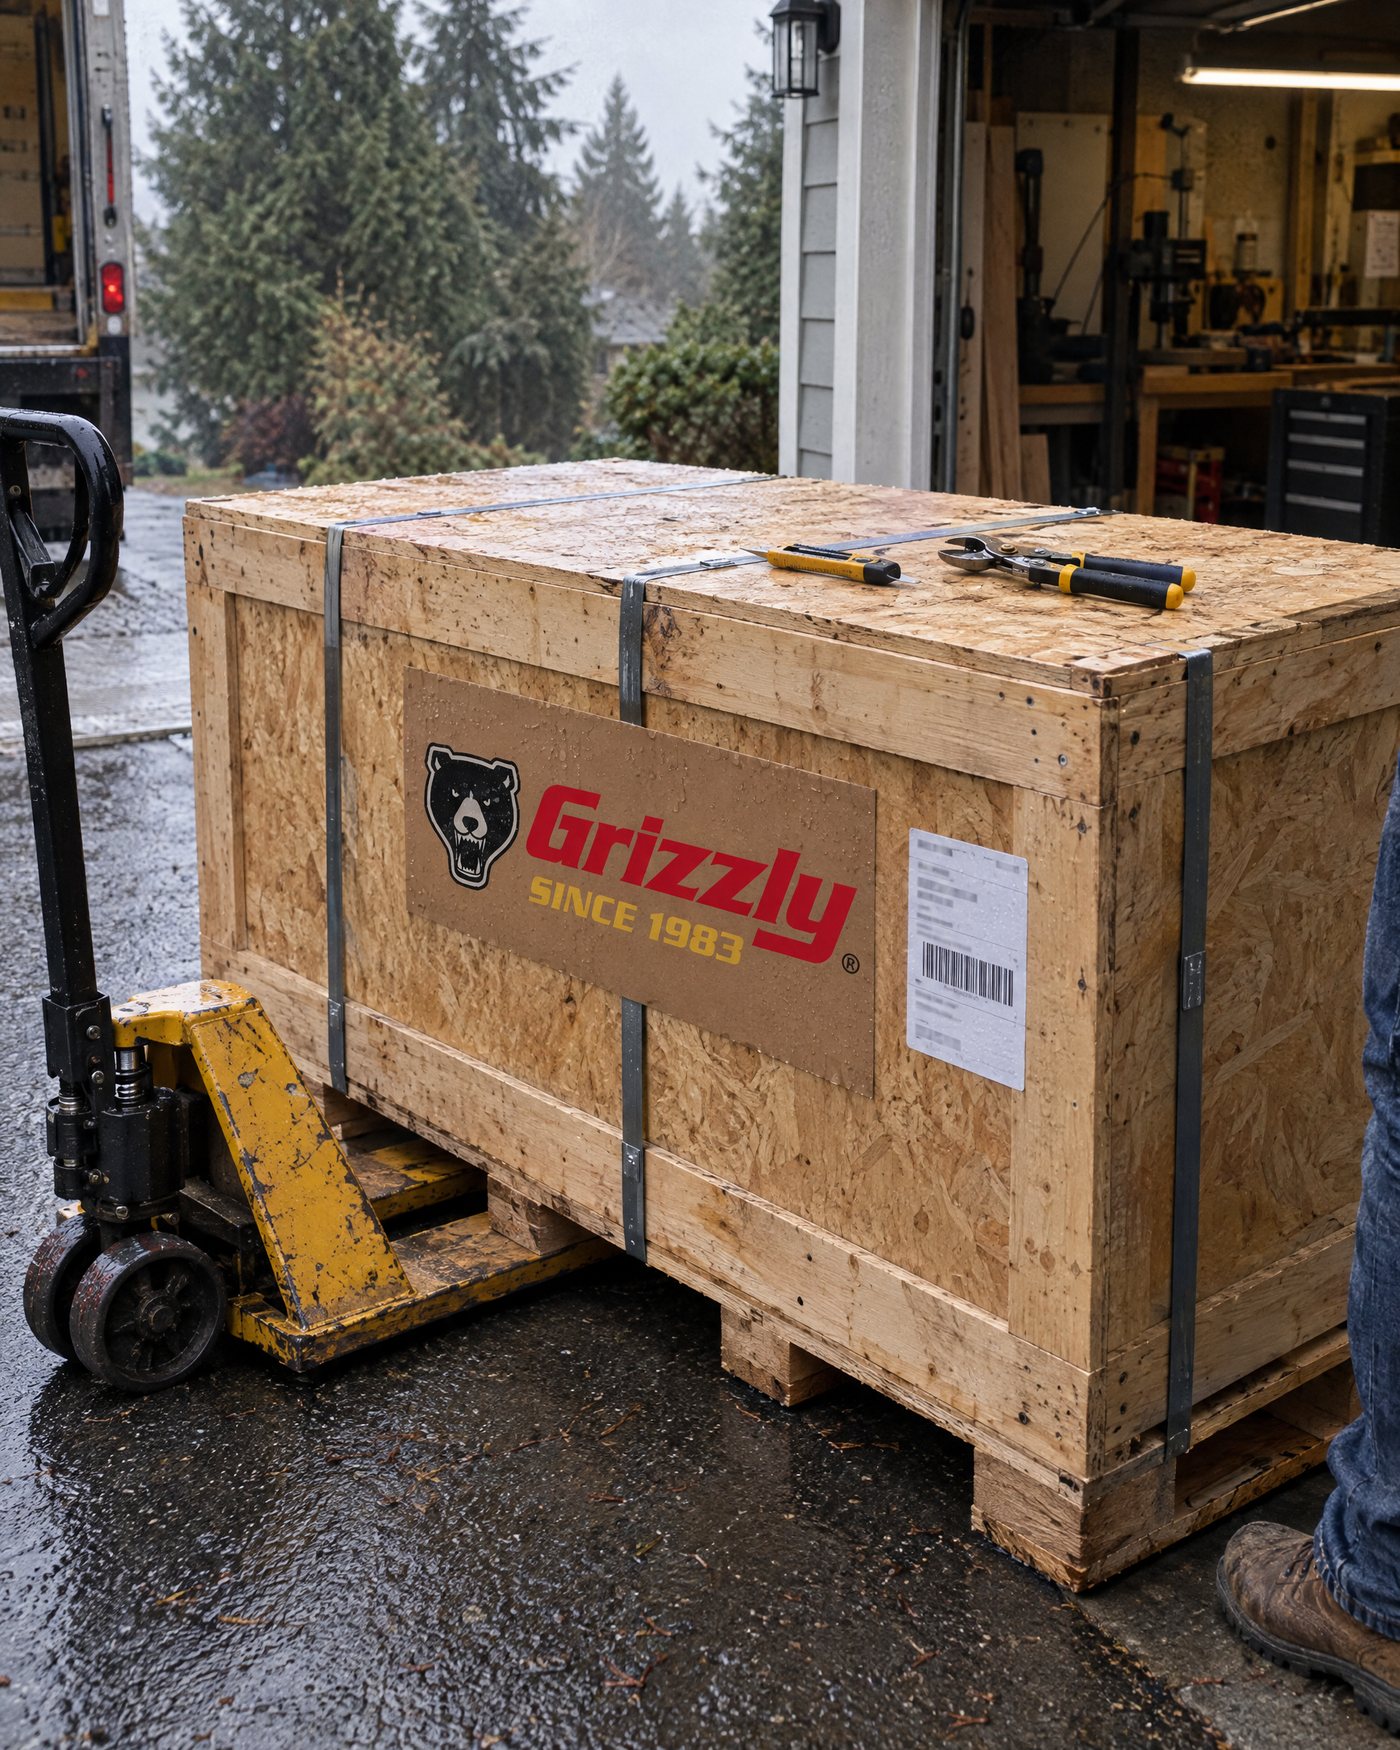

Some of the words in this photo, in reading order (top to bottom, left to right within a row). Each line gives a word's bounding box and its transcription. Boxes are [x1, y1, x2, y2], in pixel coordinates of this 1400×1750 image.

[526, 785, 857, 964] Grizzly
[528, 876, 637, 933] SINCE
[649, 912, 744, 965] 1983
